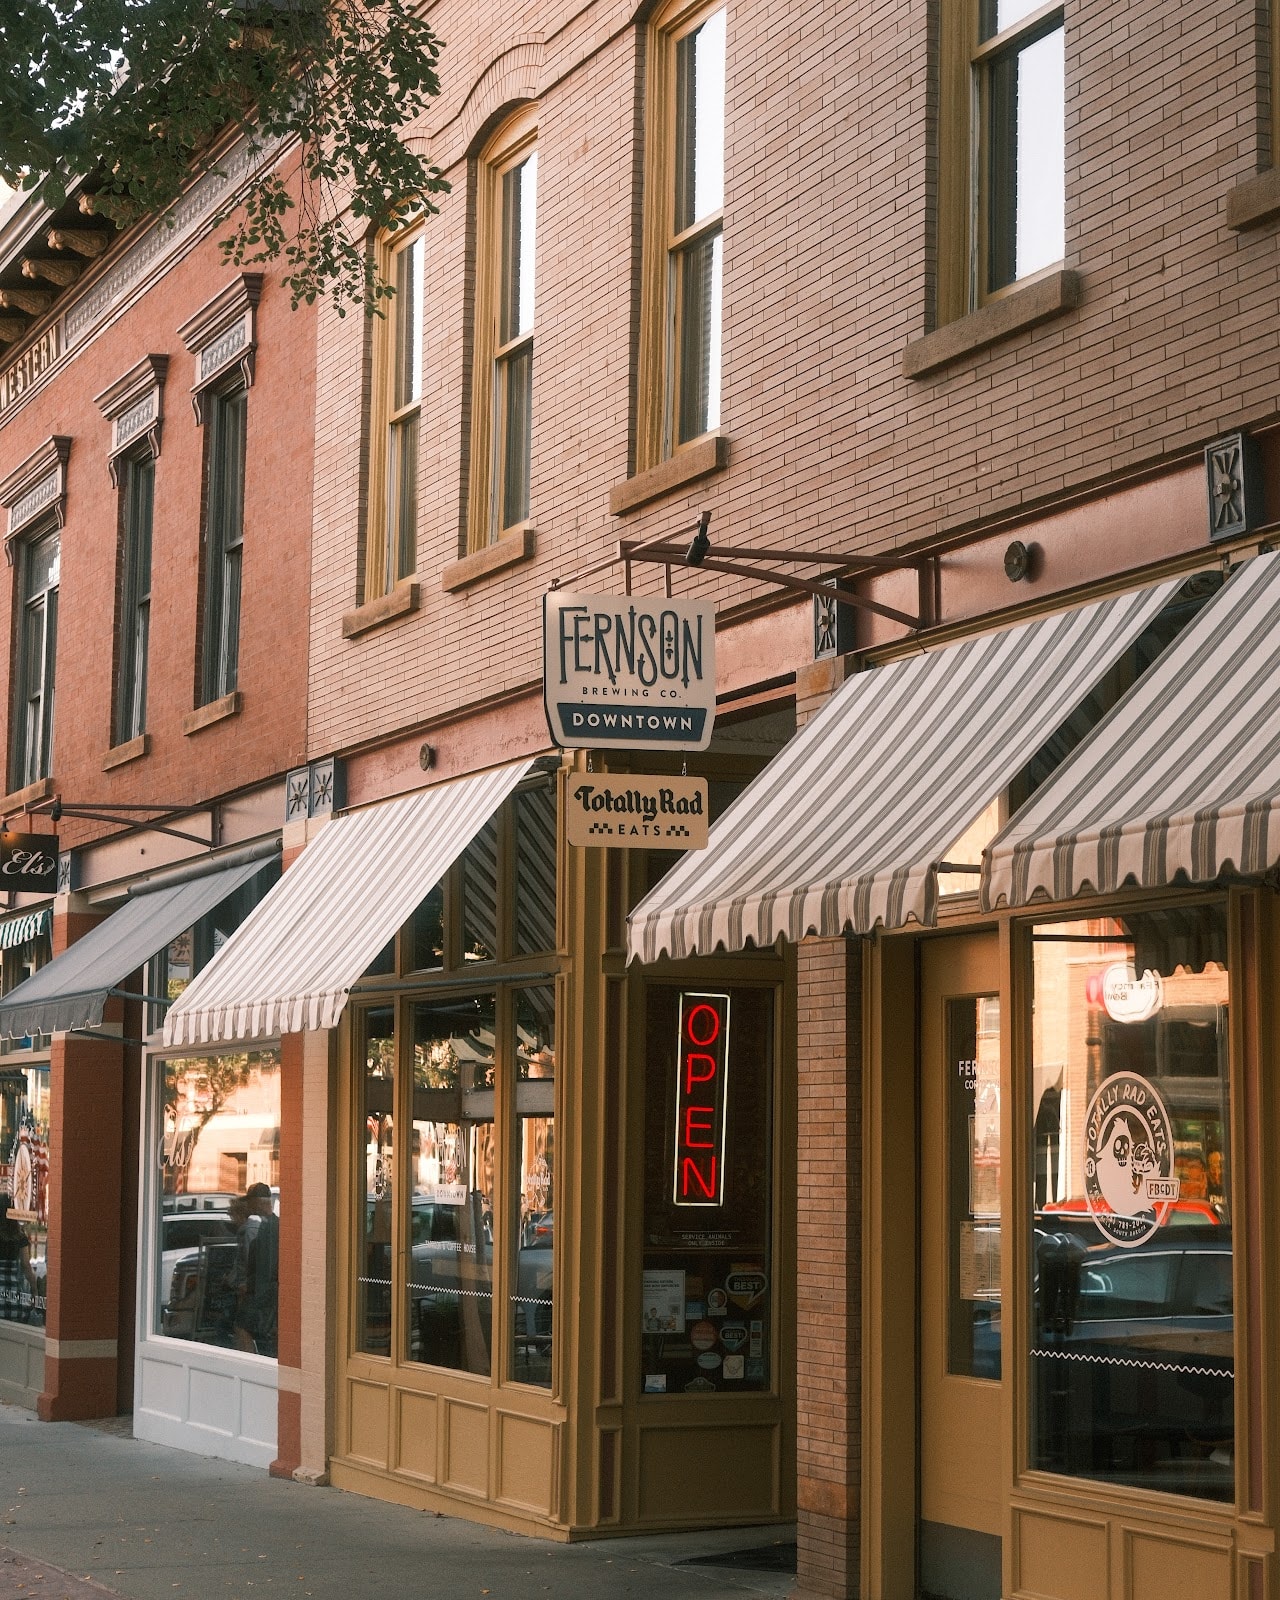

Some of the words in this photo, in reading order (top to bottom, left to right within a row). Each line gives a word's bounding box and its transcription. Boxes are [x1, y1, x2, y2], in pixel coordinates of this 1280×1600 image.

[559, 605, 703, 689] FERNSON
[582, 686, 649, 697] BREWING
[660, 689, 682, 699] CO.
[572, 712, 693, 731] DOWNTOWN
[574, 785, 658, 822] Totally
[659, 788, 704, 816] Rad
[618, 824, 661, 836] EATS
[683, 1004, 720, 1198] OPEN
[1087, 1084, 1119, 1152] TOTALLY
[1122, 1084, 1146, 1106] RAD
[1146, 1105, 1168, 1156] EATS
